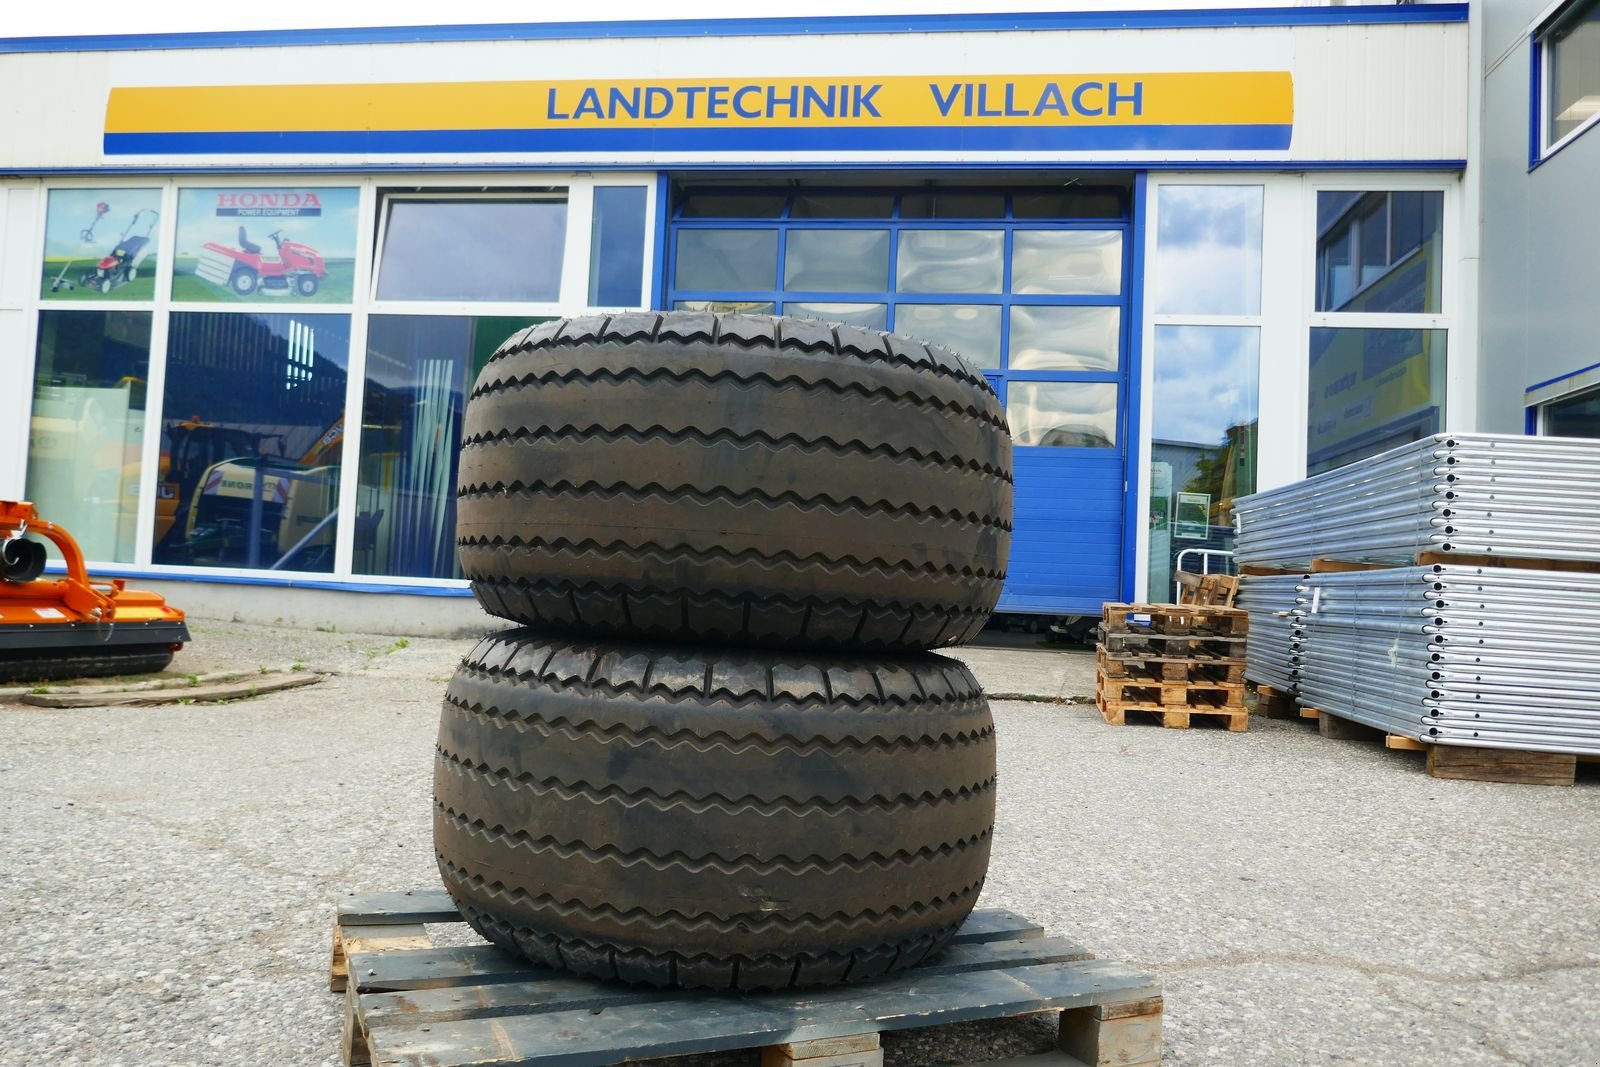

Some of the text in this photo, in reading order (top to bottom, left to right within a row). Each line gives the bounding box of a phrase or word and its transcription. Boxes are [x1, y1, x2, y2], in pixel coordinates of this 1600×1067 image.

[547, 82, 1143, 119] LANDTECHNIK VILLACH
[217, 192, 321, 208] HONDA
[238, 208, 299, 216] POWER EQUIPMENT
